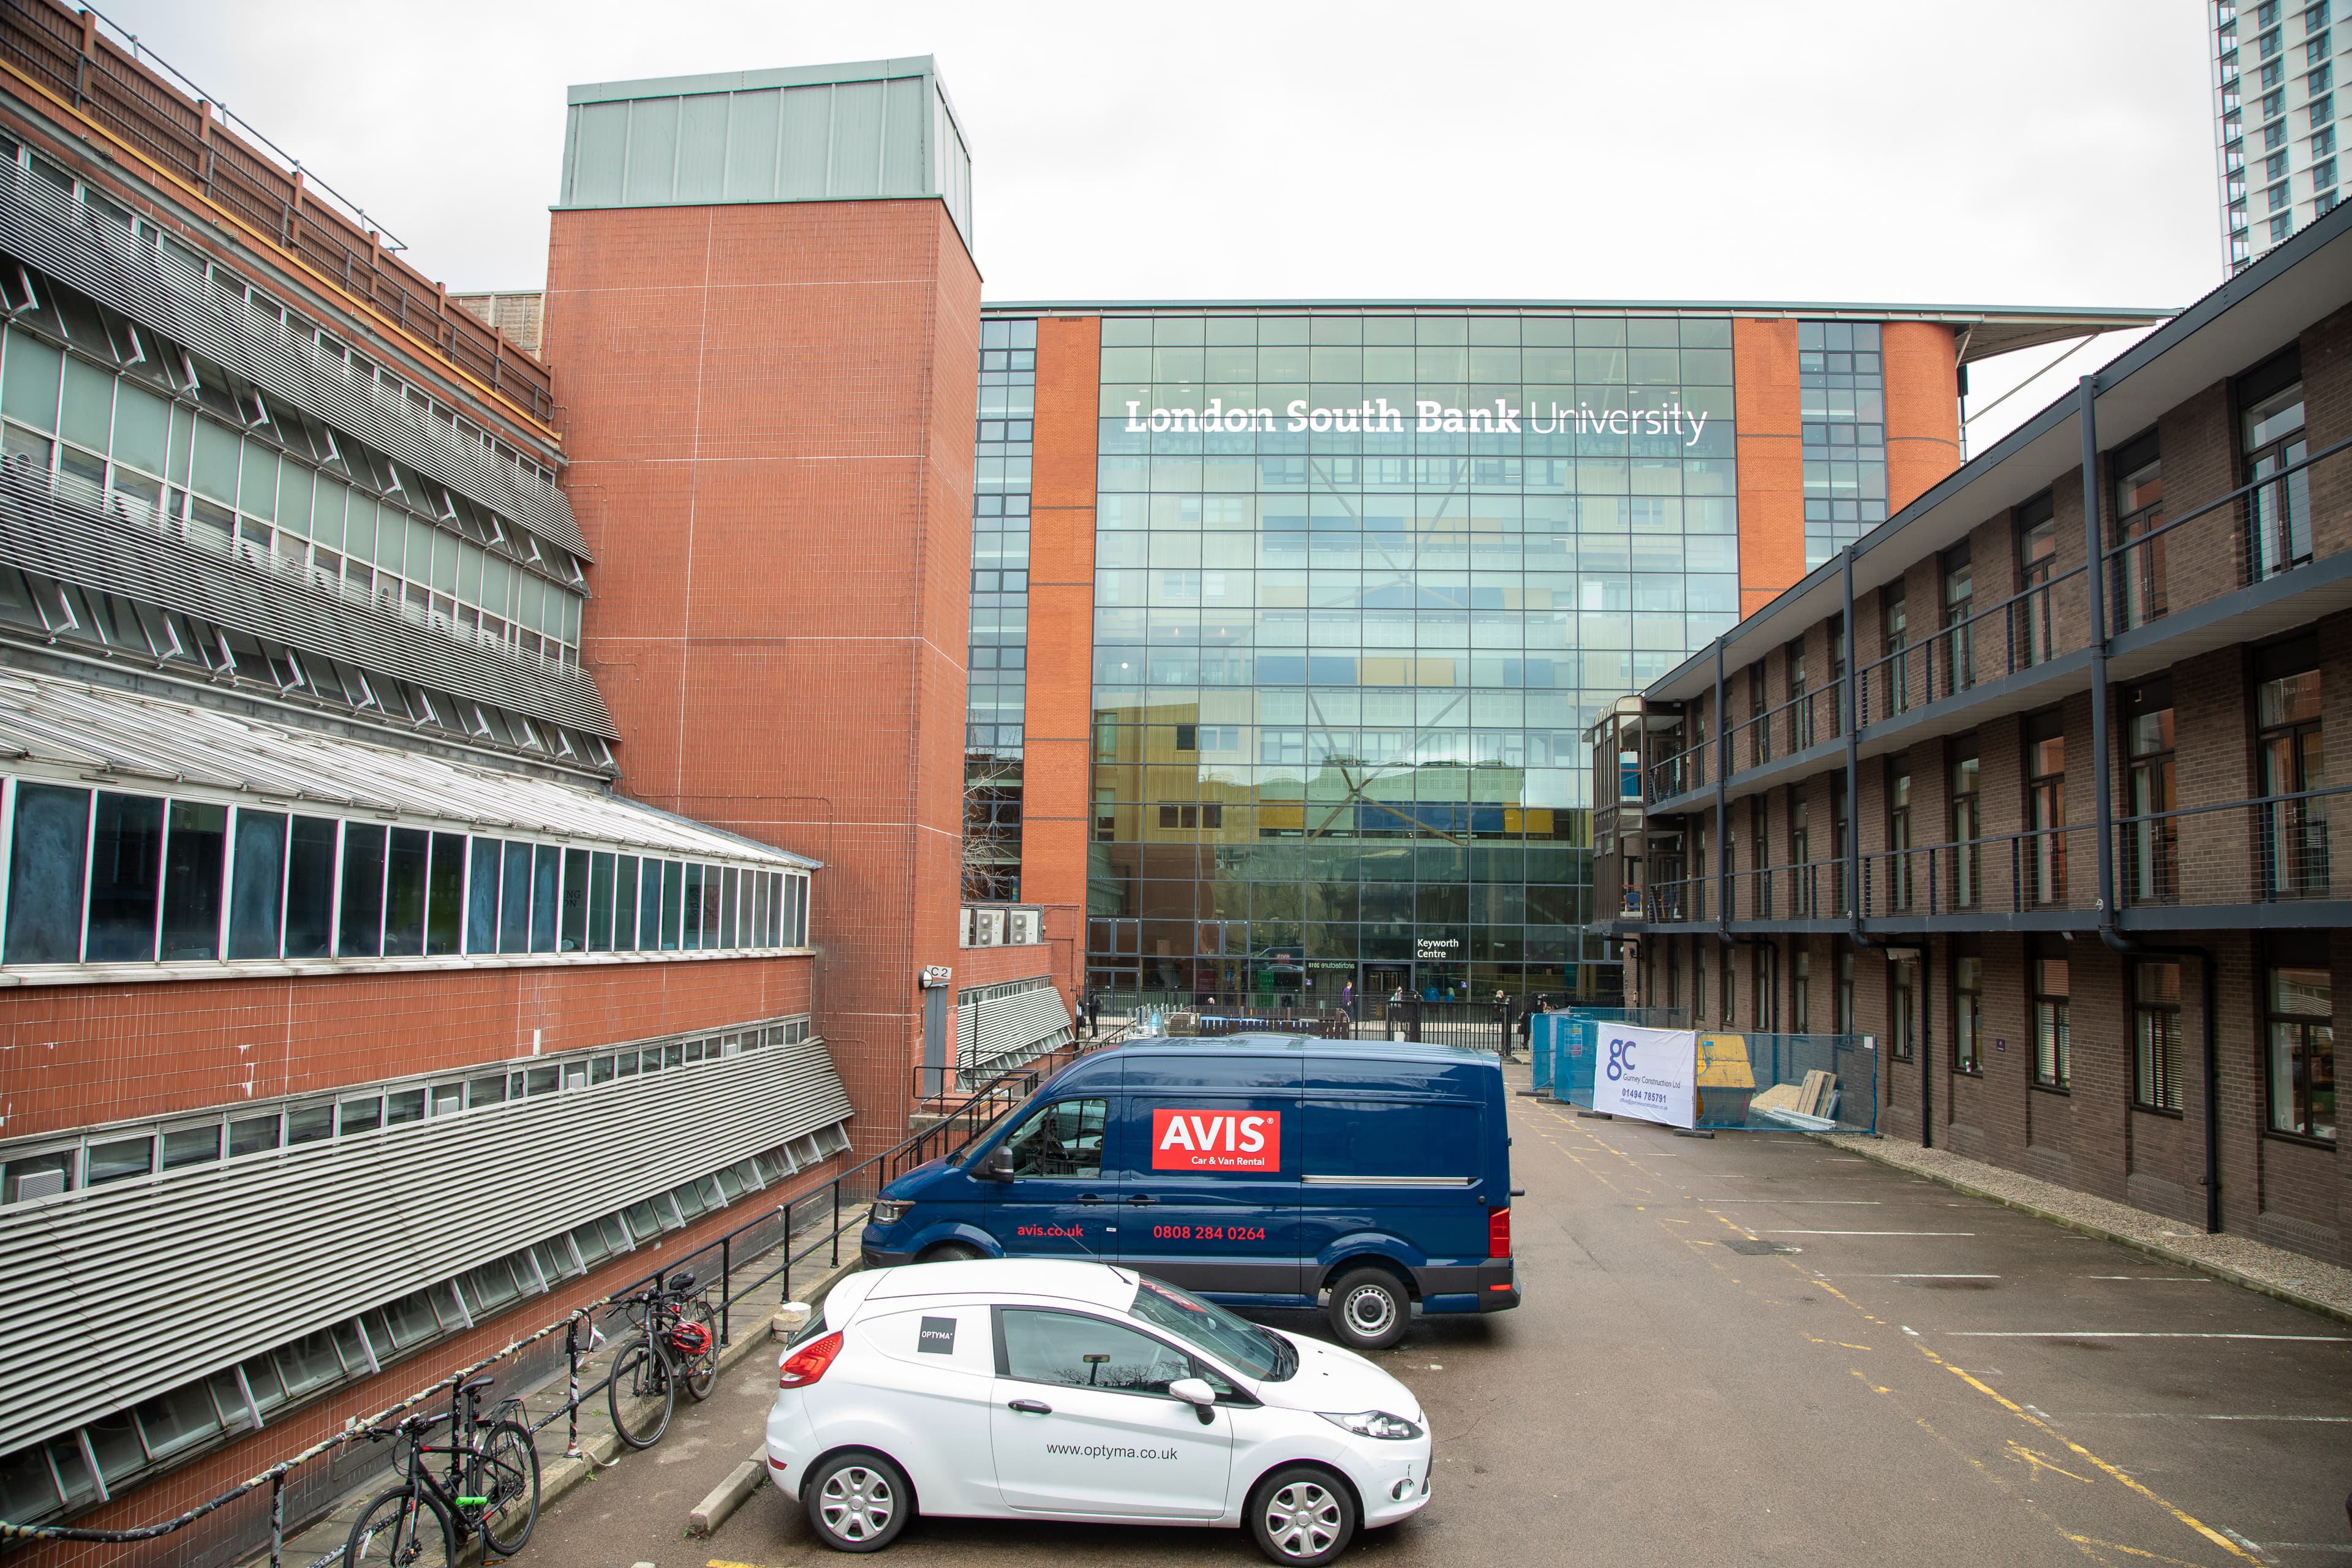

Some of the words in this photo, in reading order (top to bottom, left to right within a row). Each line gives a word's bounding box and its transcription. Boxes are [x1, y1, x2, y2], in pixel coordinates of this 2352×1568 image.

[1125, 398, 1276, 432] London
[1287, 398, 1404, 432] South
[1415, 398, 1521, 433] Bank
[1531, 401, 1708, 447] University
[1417, 938, 1459, 949] Keyworth
[1417, 949, 1446, 958] Centre
[1623, 1073, 1640, 1084] Gurney
[1642, 1076, 1672, 1087] Construction
[1622, 1088, 1642, 1099] 01494
[1644, 1091, 1666, 1103] 785791
[1017, 1224, 1084, 1237] avis.co.uk
[1153, 1226, 1191, 1239] 0808
[1195, 1227, 1223, 1240] 284
[1227, 1227, 1265, 1240] 0264
[1047, 1444, 1178, 1460] www.optyma.co.uk
